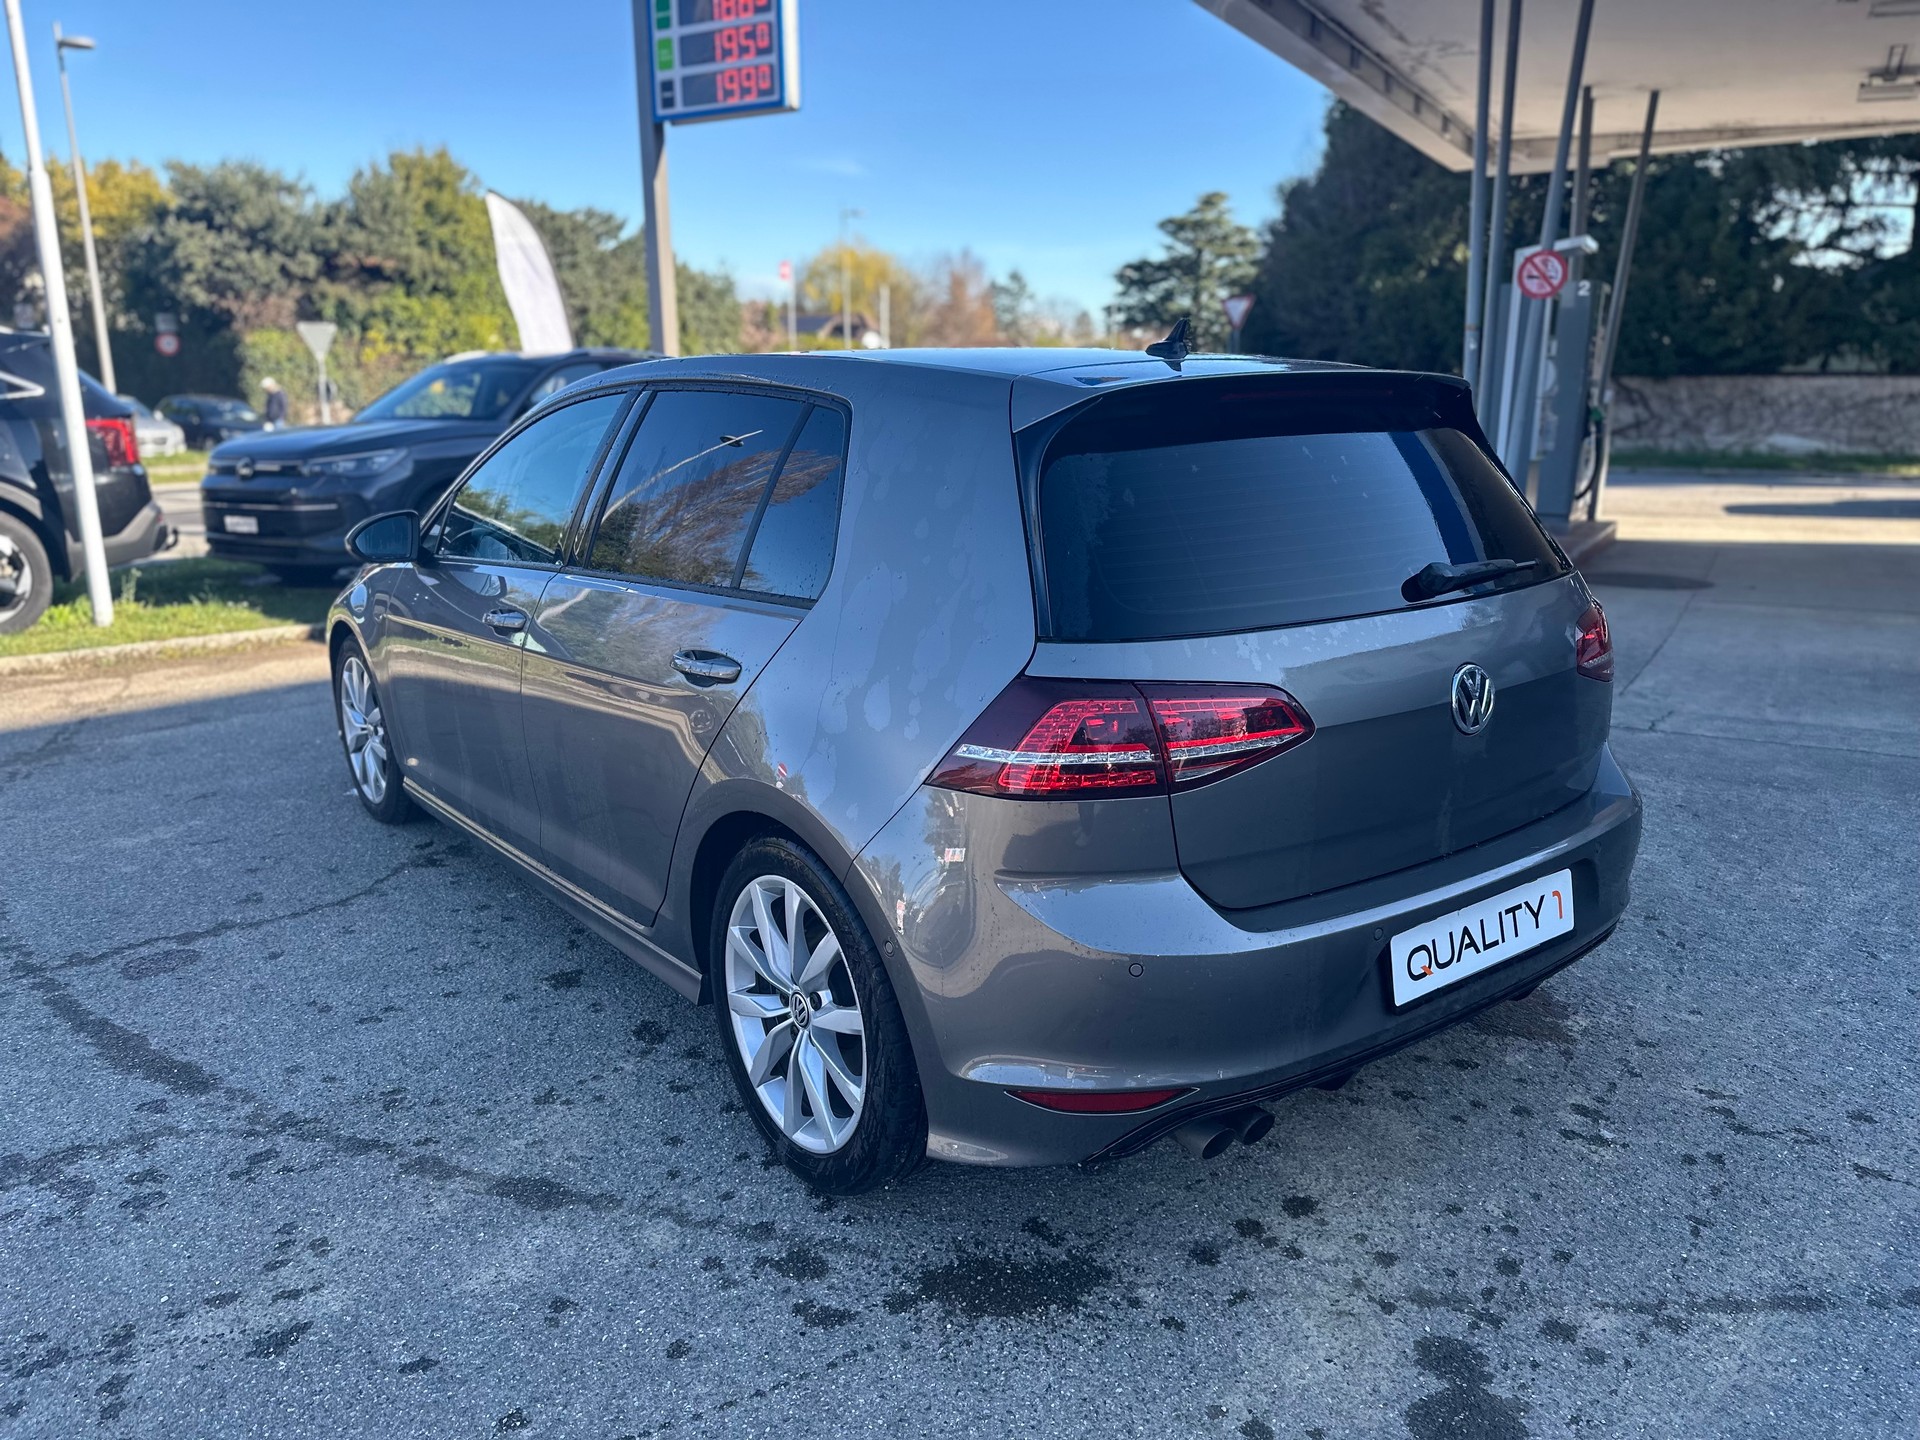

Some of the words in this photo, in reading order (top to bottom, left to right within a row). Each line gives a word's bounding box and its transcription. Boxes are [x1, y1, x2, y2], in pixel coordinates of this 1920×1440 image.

[714, 22, 770, 63] 1950
[716, 64, 771, 104] 1990
[1577, 279, 1591, 296] 2
[1407, 894, 1545, 981] QUALITY
[1552, 890, 1563, 919] 1
